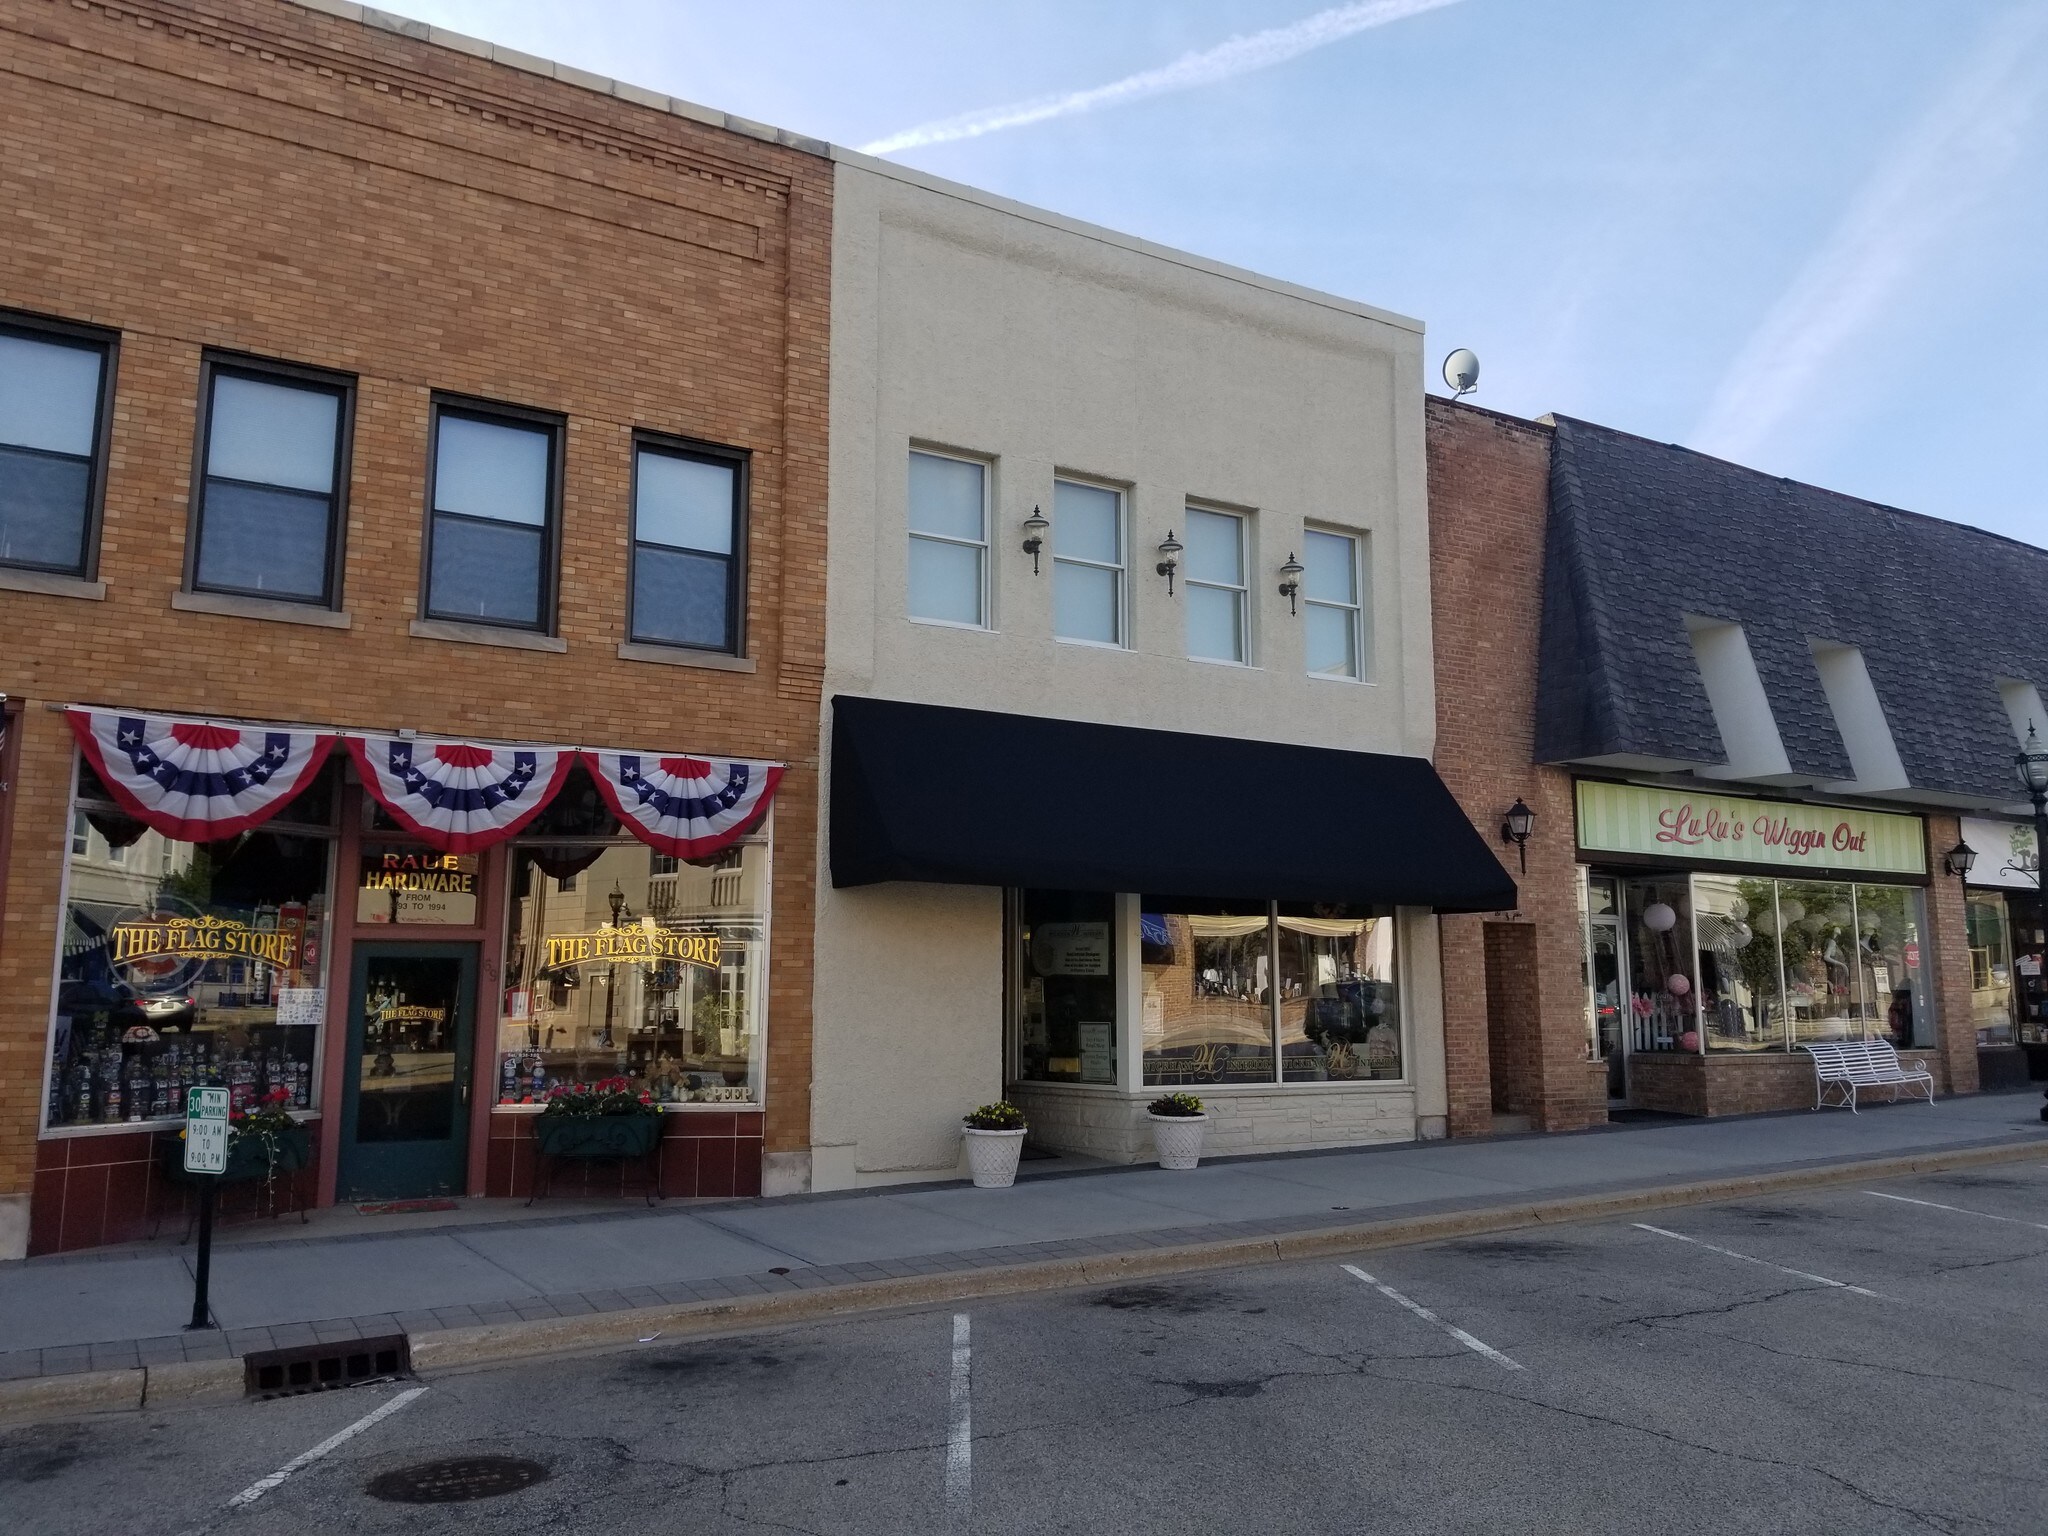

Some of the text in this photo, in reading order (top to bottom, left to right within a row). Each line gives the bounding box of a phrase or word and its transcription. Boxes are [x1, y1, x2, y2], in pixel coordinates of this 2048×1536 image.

[1655, 803, 1867, 856] Lulu's Wiggin Out
[382, 853, 460, 871] RAUE
[365, 871, 473, 892] HARDWARE
[405, 893, 431, 901] FROM
[412, 902, 424, 910] TO
[428, 903, 447, 911] 1994
[112, 926, 292, 969] THE FLAG STORE
[546, 936, 721, 969] THE FLAG STORE
[381, 1009, 444, 1021] THE FLAG STORE
[189, 1097, 201, 1112] 30
[209, 1093, 221, 1104] MIN
[201, 1105, 226, 1117] PARKING
[192, 1124, 222, 1136] 9:00 AM
[202, 1139, 211, 1149] TO
[191, 1152, 221, 1164] 9:00 PM
